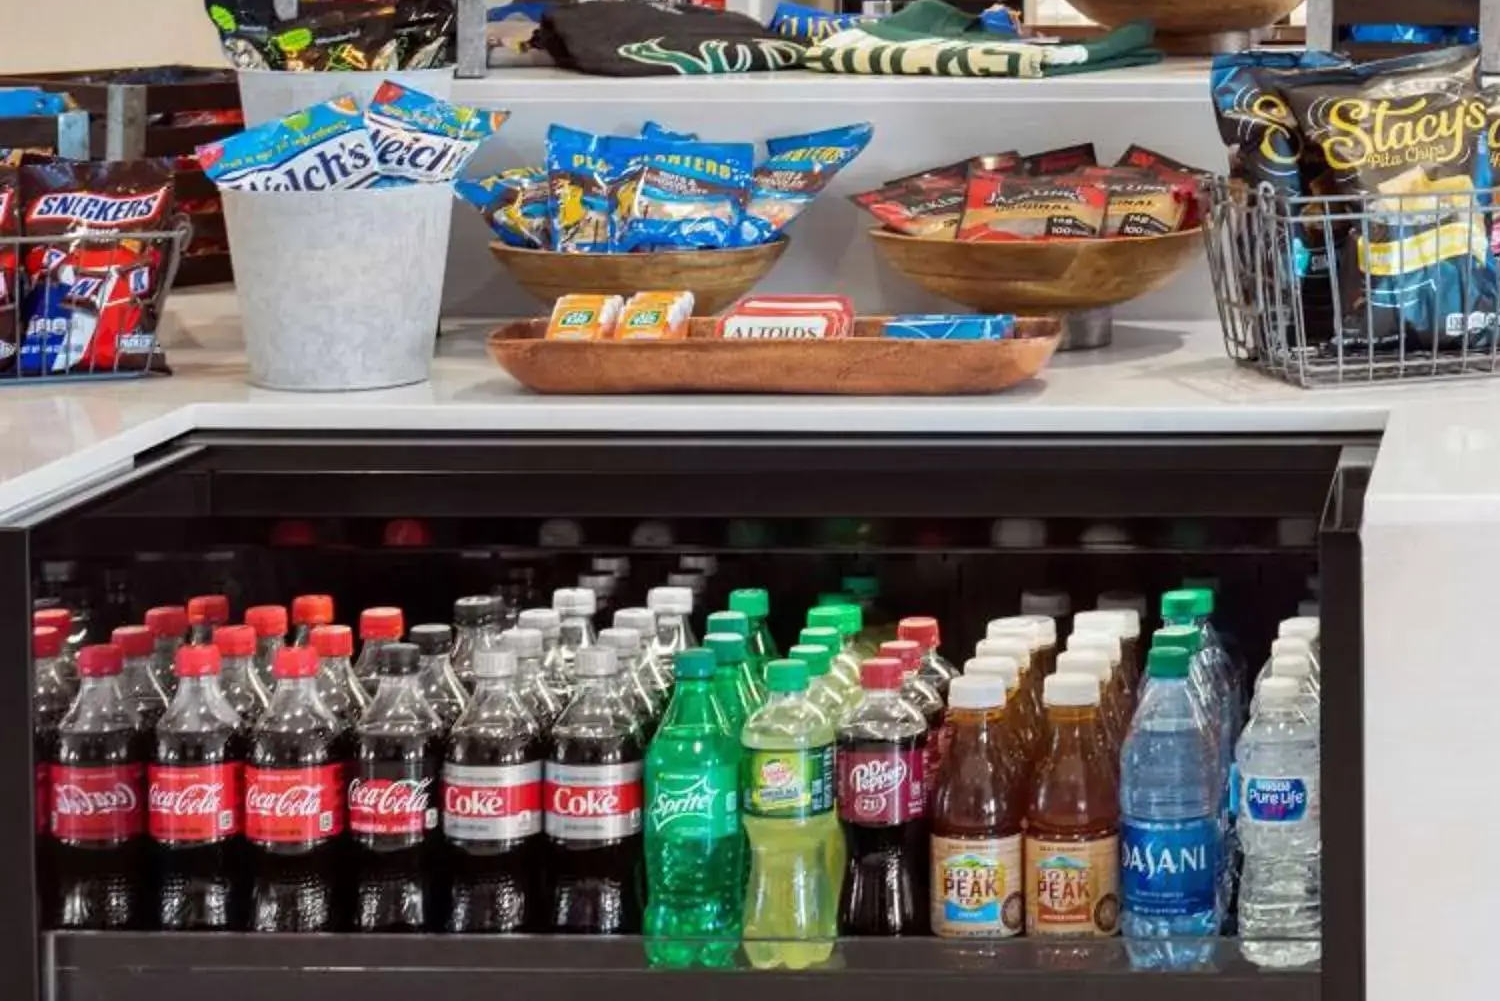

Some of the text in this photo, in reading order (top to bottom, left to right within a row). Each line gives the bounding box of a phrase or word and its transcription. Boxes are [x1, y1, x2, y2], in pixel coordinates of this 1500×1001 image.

[1321, 96, 1486, 171] Stacy's
[230, 141, 372, 191] lch's
[1366, 142, 1448, 169] Pita Chips
[36, 195, 156, 222] SNICKERS
[733, 325, 818, 339] ALTOIDS
[868, 760, 889, 777] Dr
[149, 782, 224, 815] Coca-Cola
[245, 784, 324, 816] Coca-Cola
[349, 777, 433, 815] Coca-Cola
[444, 786, 504, 816] Coke
[553, 787, 620, 816] Coke
[652, 792, 710, 817] Sprite
[1248, 788, 1305, 810] Pure Life
[943, 878, 999, 897] PEAK
[1037, 880, 1091, 899] PEAK
